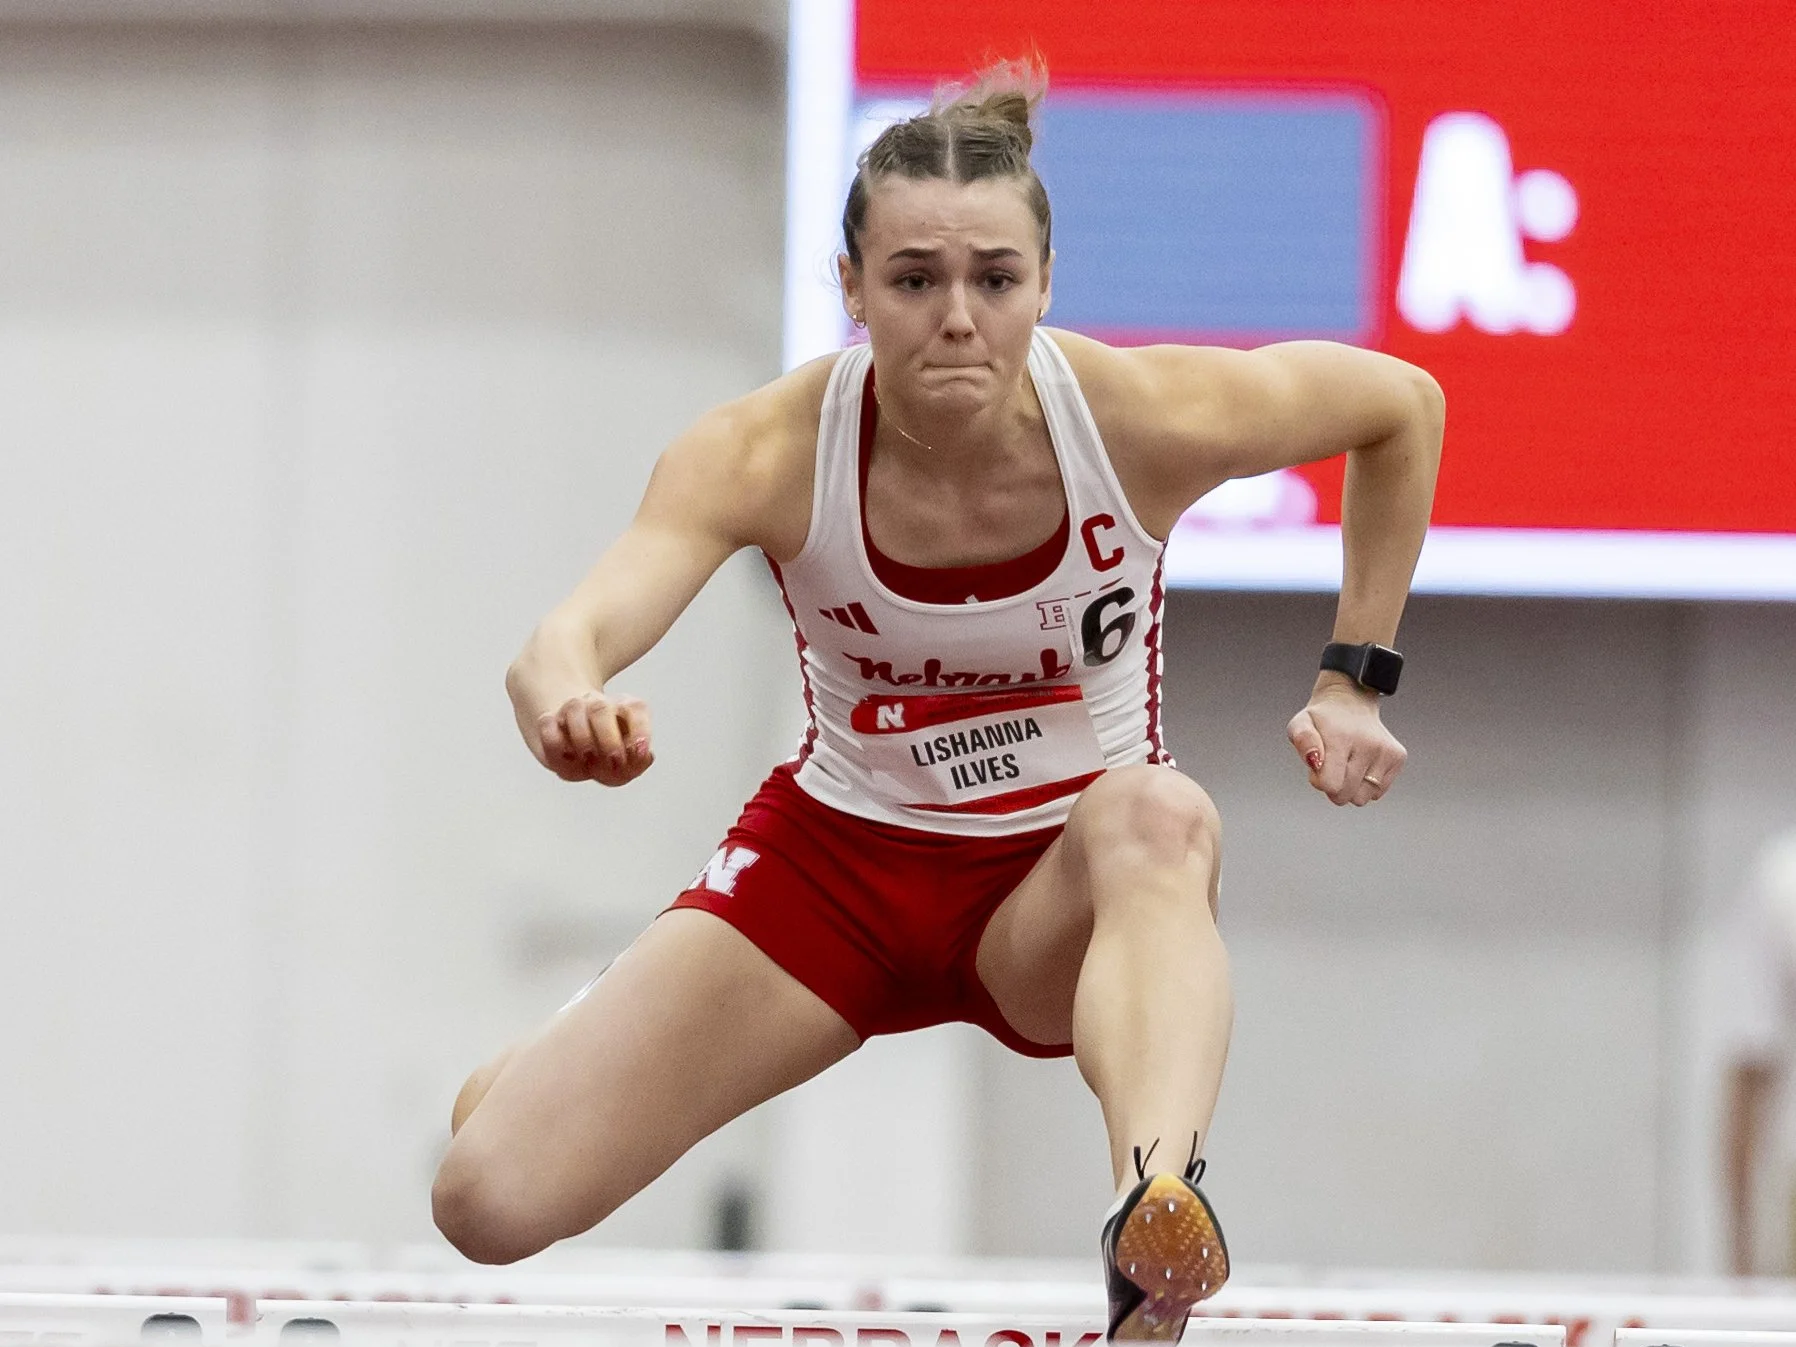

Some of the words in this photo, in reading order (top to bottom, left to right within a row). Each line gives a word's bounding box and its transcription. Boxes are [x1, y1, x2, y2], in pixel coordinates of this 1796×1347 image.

[1081, 513, 1125, 572] C
[1081, 587, 1136, 667] 6
[842, 648, 1071, 686] Nebrask
[876, 703, 906, 730] N
[910, 717, 1043, 767] LISHANNA
[950, 753, 1020, 790] ILVES
[687, 846, 760, 897] N
